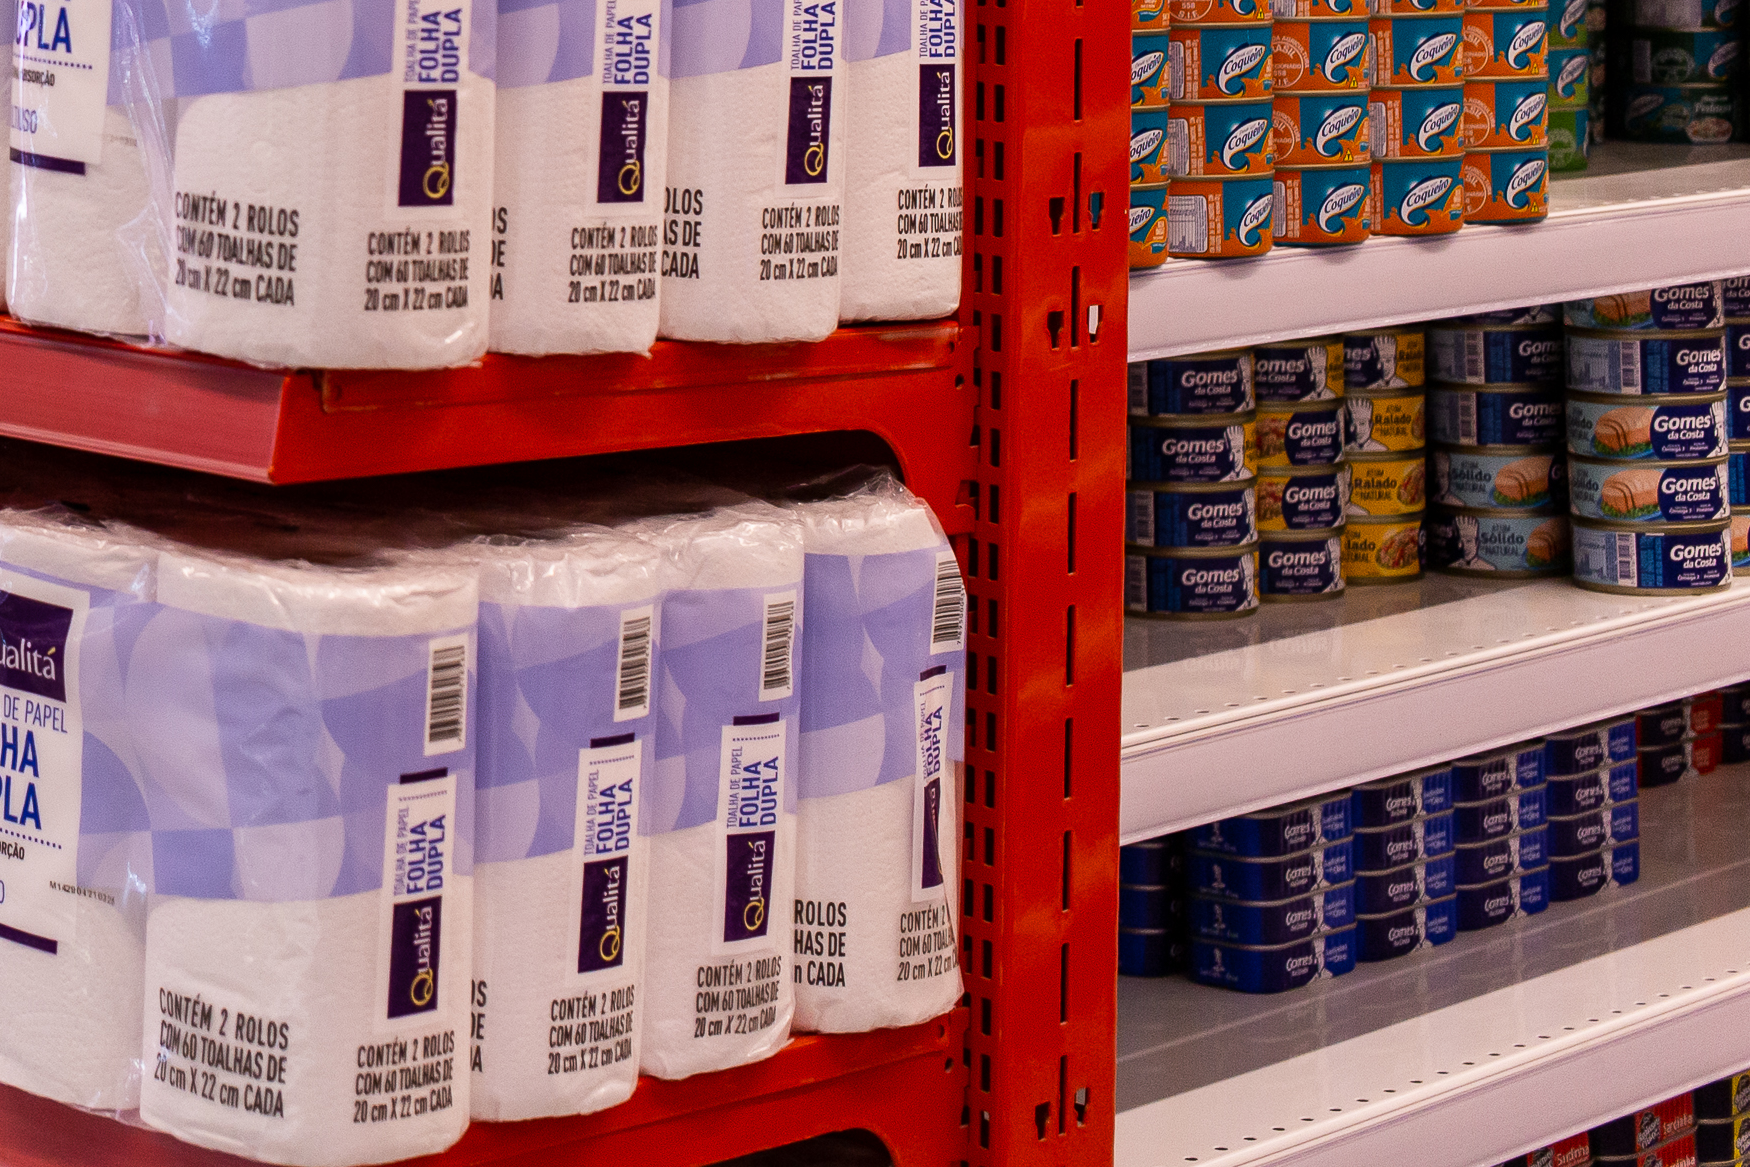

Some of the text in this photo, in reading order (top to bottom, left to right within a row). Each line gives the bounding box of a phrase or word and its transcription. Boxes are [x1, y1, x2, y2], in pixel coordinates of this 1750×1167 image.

[792, 20, 802, 32] DE
[801, 4, 820, 70] FOLHA
[818, 2, 836, 70] DUPLA
[920, 11, 928, 22] DE
[920, 25, 928, 58] TOALHA
[418, 12, 441, 83] FOLHA
[441, 9, 462, 83] DUPLA
[614, 15, 634, 84] FOLHA
[634, 13, 653, 84] DUPLA
[791, 35, 800, 70] TOALHA
[1224, 47, 1265, 75] Coqueiro
[804, 85, 824, 176] Qualitá
[937, 71, 953, 159] Qualitá
[1228, 121, 1266, 150] Coqueiro
[1322, 108, 1360, 137] Coqueiro
[423, 99, 450, 199] Qualitá
[618, 99, 640, 195] Qualitá
[1325, 187, 1363, 214] Coqueiro
[1407, 178, 1449, 208] Coqueiro
[1182, 368, 1237, 387] Gomes
[1375, 414, 1412, 425] Ralado
[1654, 415, 1711, 432] Gomes
[1668, 429, 1705, 440] da Costa
[1354, 479, 1398, 490] Ralado
[1662, 475, 1716, 493] Gomes
[1268, 551, 1325, 569] Gomes
[1481, 533, 1525, 545] Sólido
[1670, 544, 1723, 562] Gomes
[4, 695, 68, 734] DE PAPEL
[615, 778, 633, 850] DUPLA
[739, 761, 762, 828] FOLHA
[760, 757, 779, 826] DUPLA
[596, 784, 617, 855] FOLHA
[407, 821, 428, 894] FOLHA
[426, 815, 446, 891] DUPLA
[744, 839, 766, 931] Qualitá
[600, 866, 620, 961] Qualitá
[411, 905, 434, 1005] Qualitá
